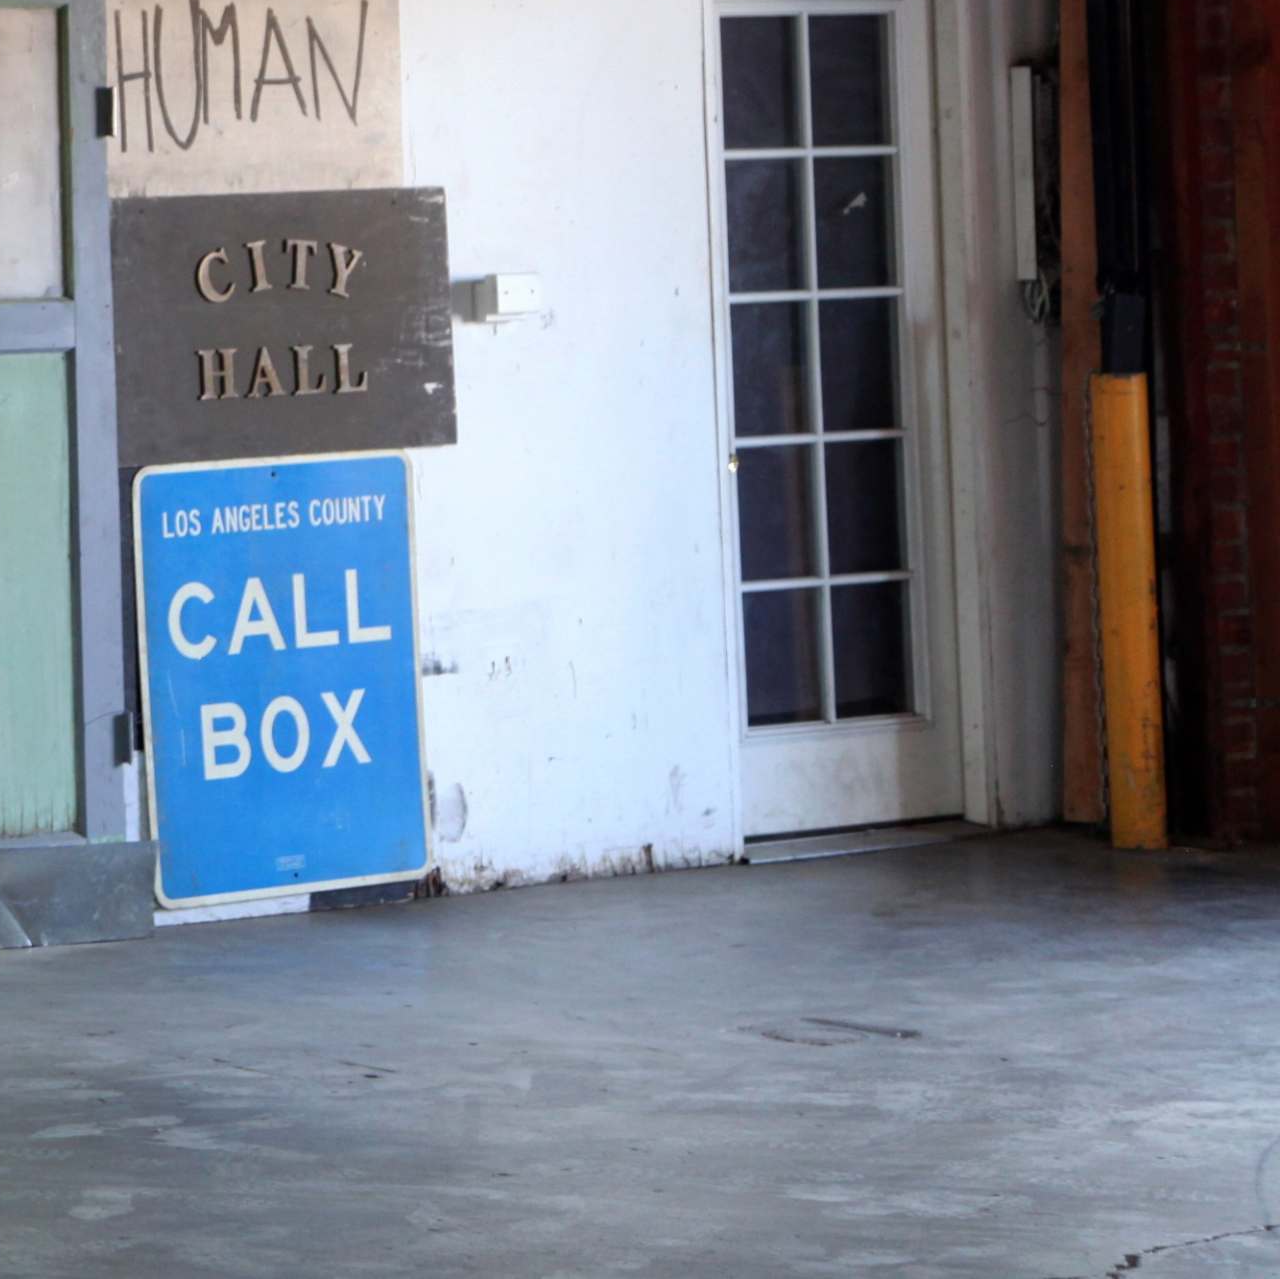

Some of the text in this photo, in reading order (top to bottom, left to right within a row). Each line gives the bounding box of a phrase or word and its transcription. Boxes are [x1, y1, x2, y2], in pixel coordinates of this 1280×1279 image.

[195, 238, 364, 304] CITY
[195, 342, 369, 402] HALL
[161, 494, 387, 539] LOS ANGELES COUNTY
[166, 567, 393, 662] CALL
[199, 686, 373, 782] BOX
